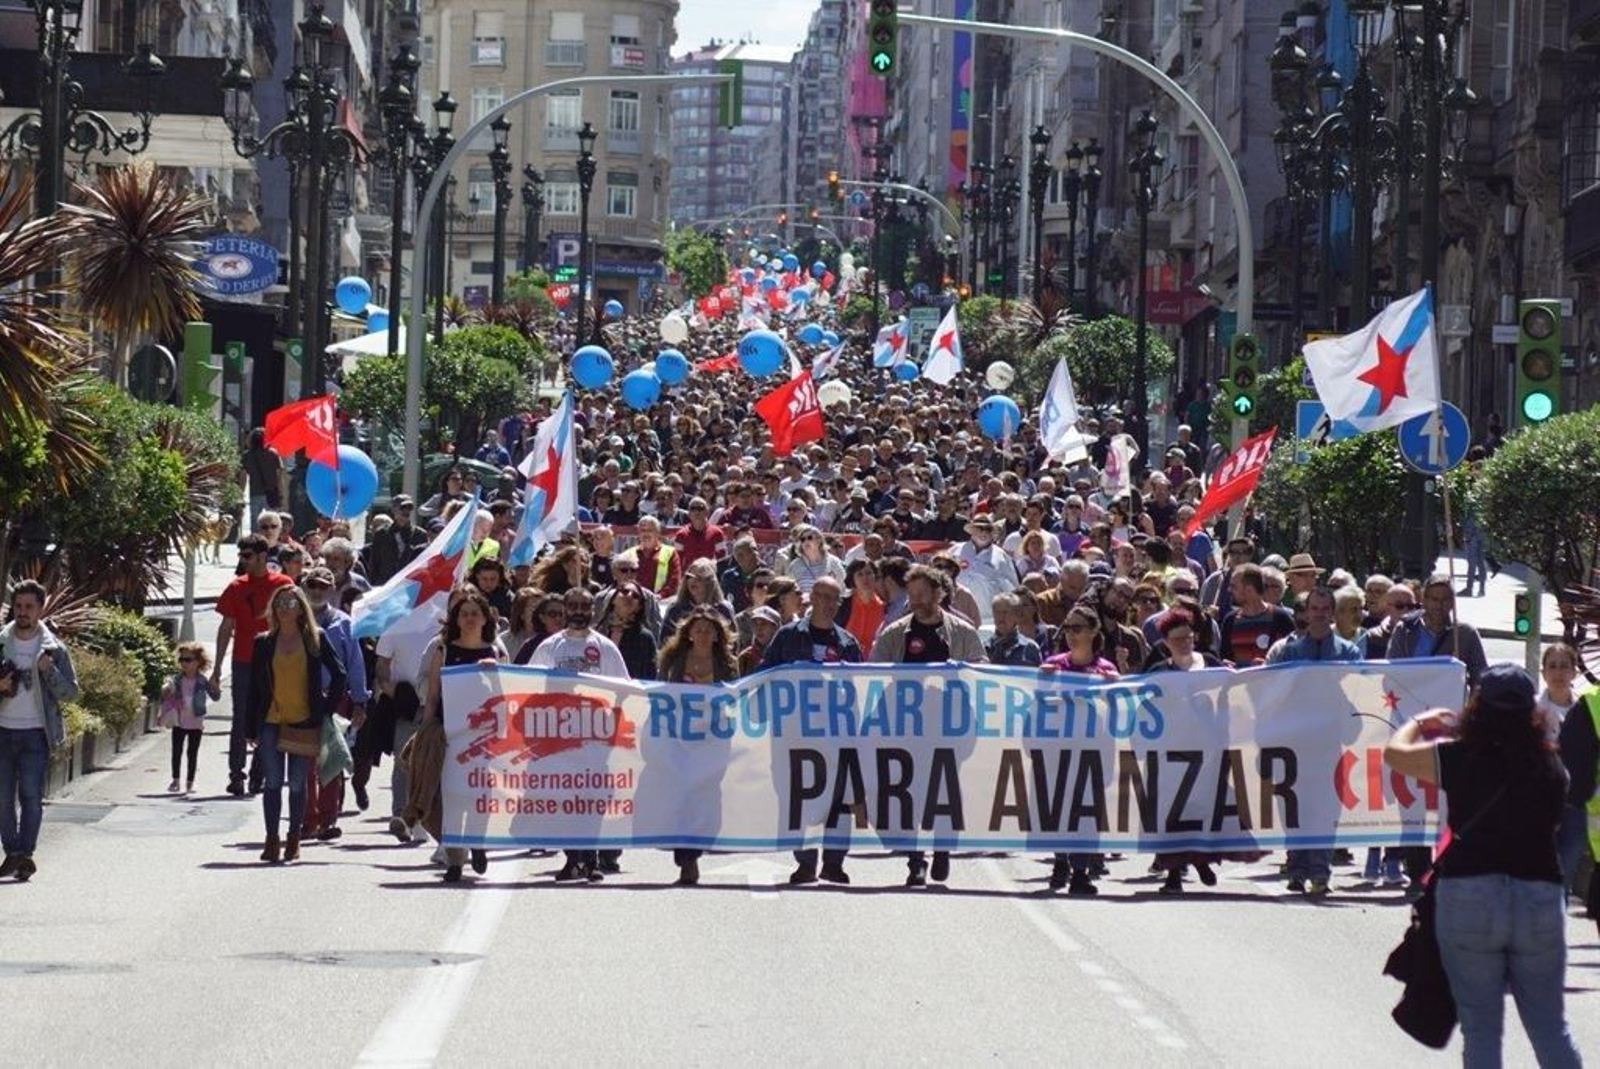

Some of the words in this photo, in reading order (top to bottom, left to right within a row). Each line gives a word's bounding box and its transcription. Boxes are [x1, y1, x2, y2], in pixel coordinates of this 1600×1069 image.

[205, 238, 276, 264] FETERIA
[523, 702, 617, 739] maio
[648, 679, 924, 741] RECUPERAR
[941, 680, 1166, 740] DEREITOS
[502, 768, 634, 790] internacional
[788, 747, 965, 832] PARA
[987, 746, 1300, 834] AVANZAR
[475, 794, 500, 814] da
[504, 794, 558, 815] clase
[562, 795, 634, 815] obreira
